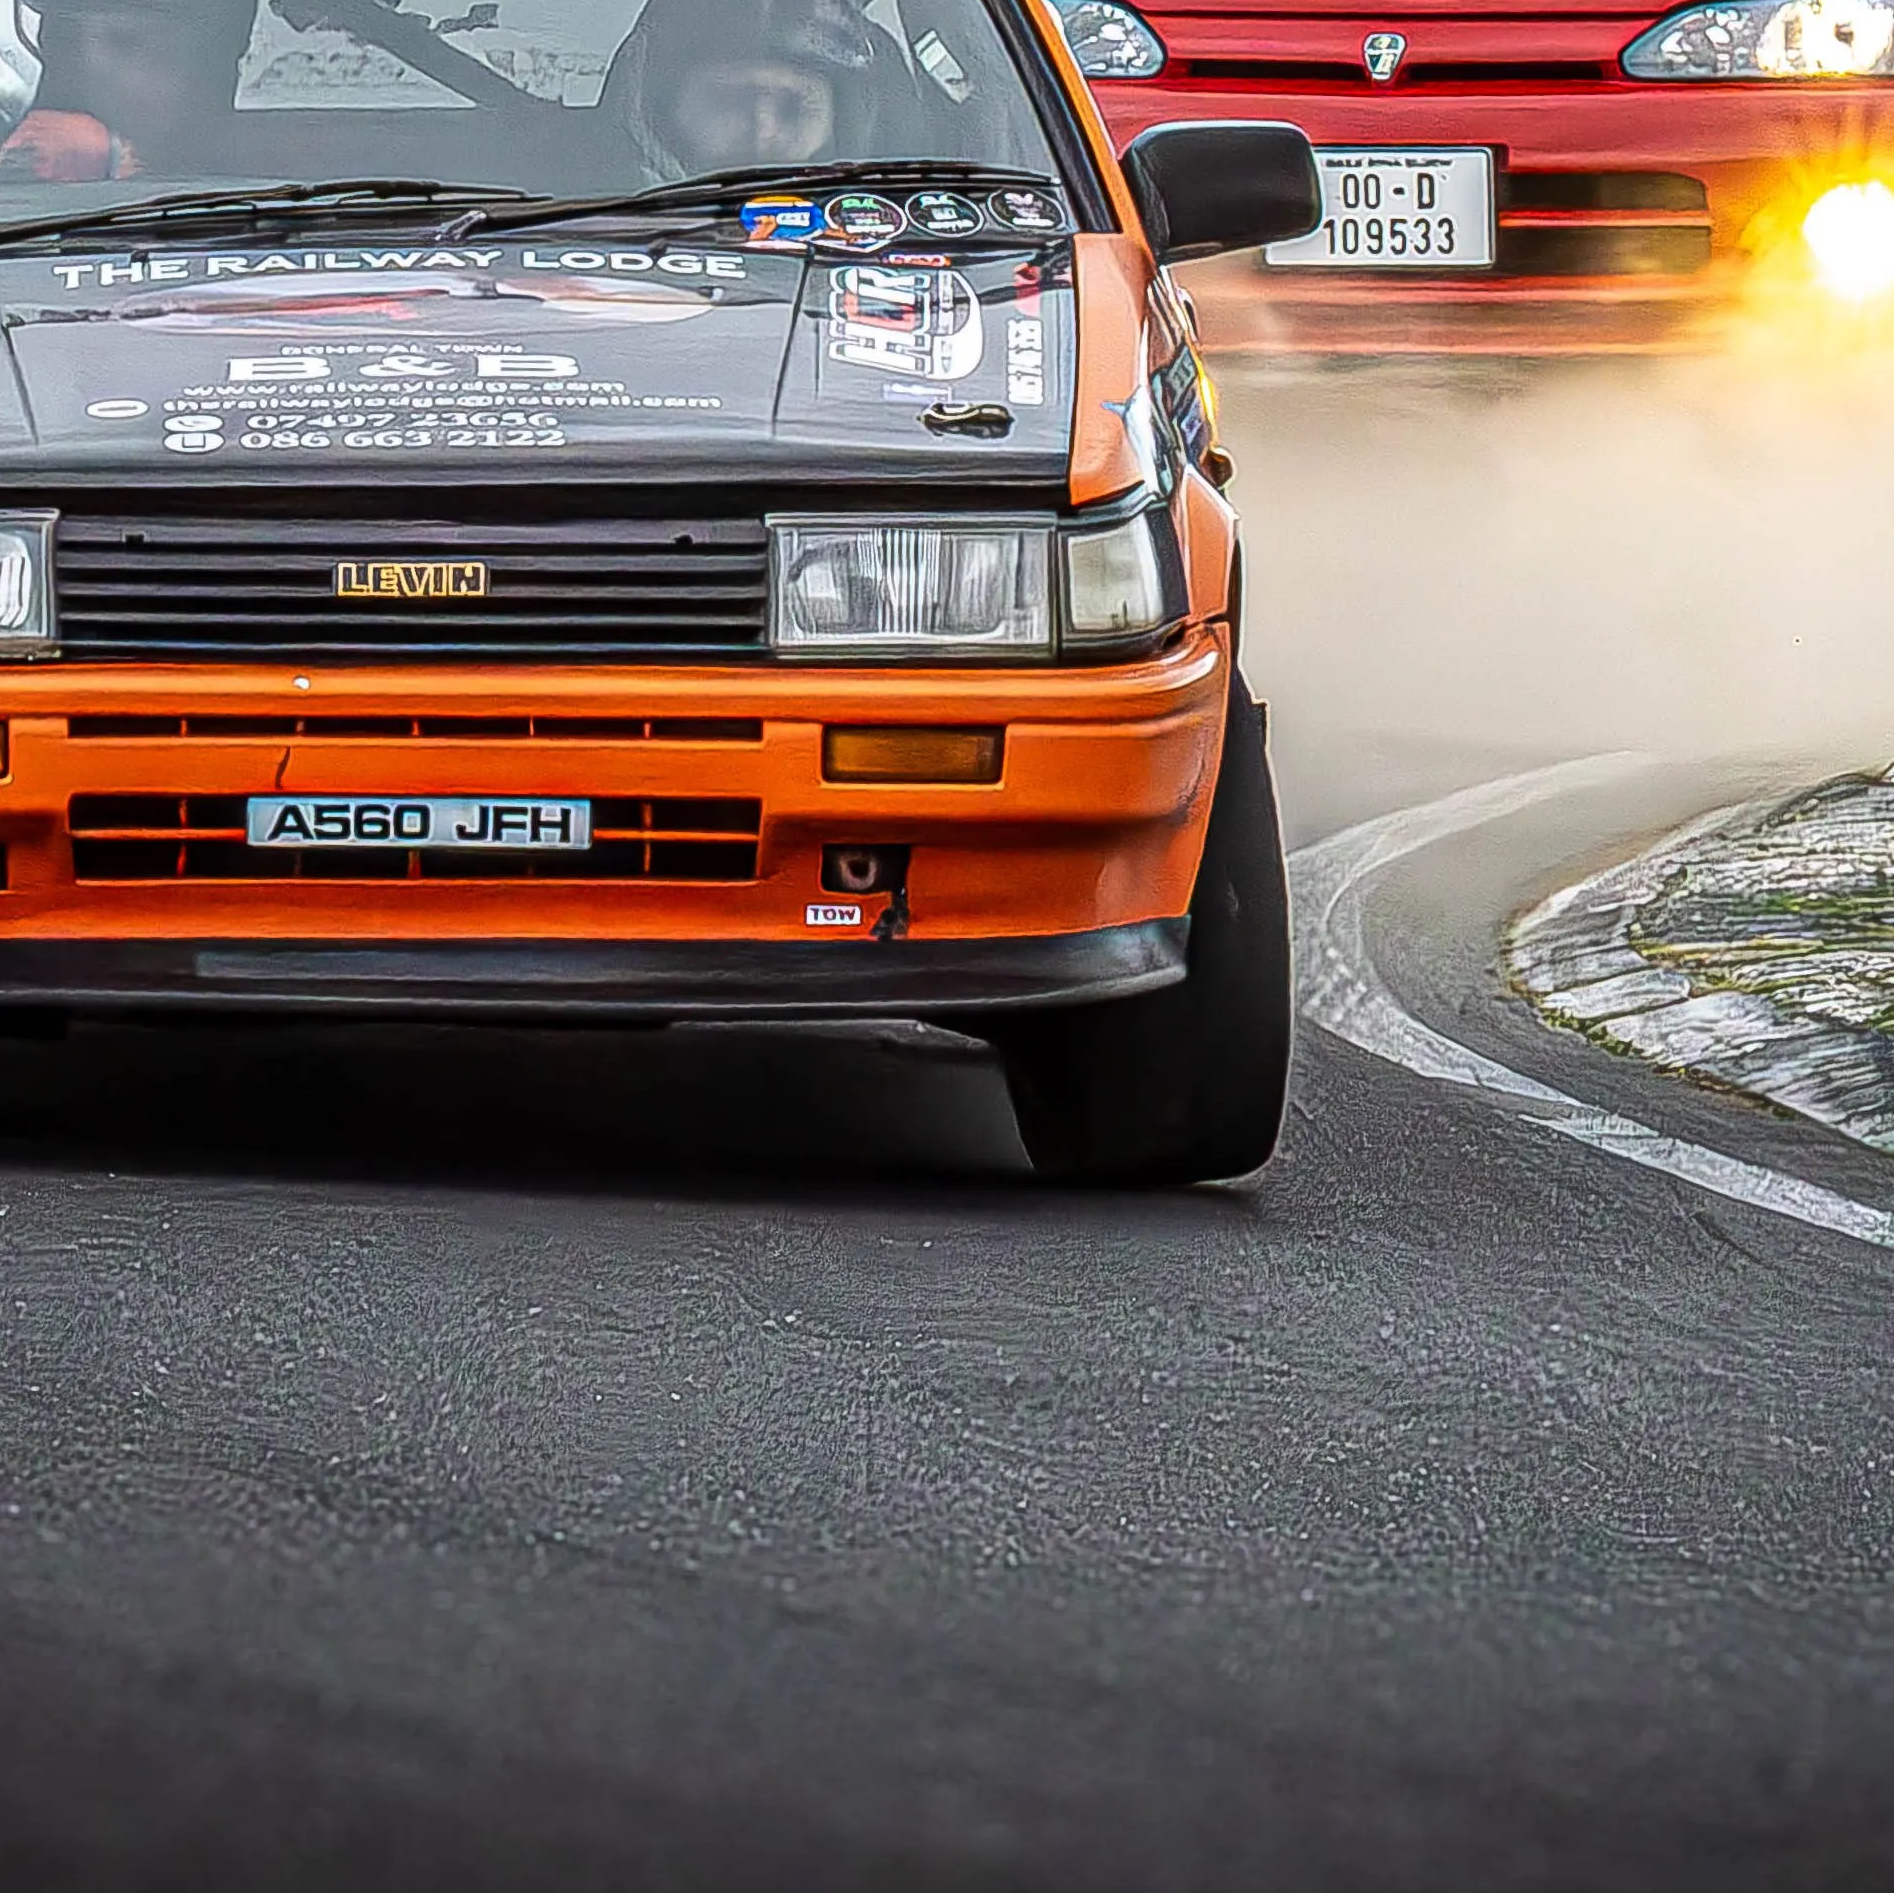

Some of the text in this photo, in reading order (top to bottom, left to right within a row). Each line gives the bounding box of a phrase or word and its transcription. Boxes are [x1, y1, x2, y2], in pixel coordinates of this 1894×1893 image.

[1322, 217, 1455, 255] 109533
[52, 249, 747, 290] THE RAILWAY LODGE
[227, 356, 580, 381] B & B
[239, 430, 566, 449] 086 663 2122
[337, 562, 486, 596] LEVIN
[267, 804, 572, 844] A560 JFH
[810, 907, 856, 921] TOW
